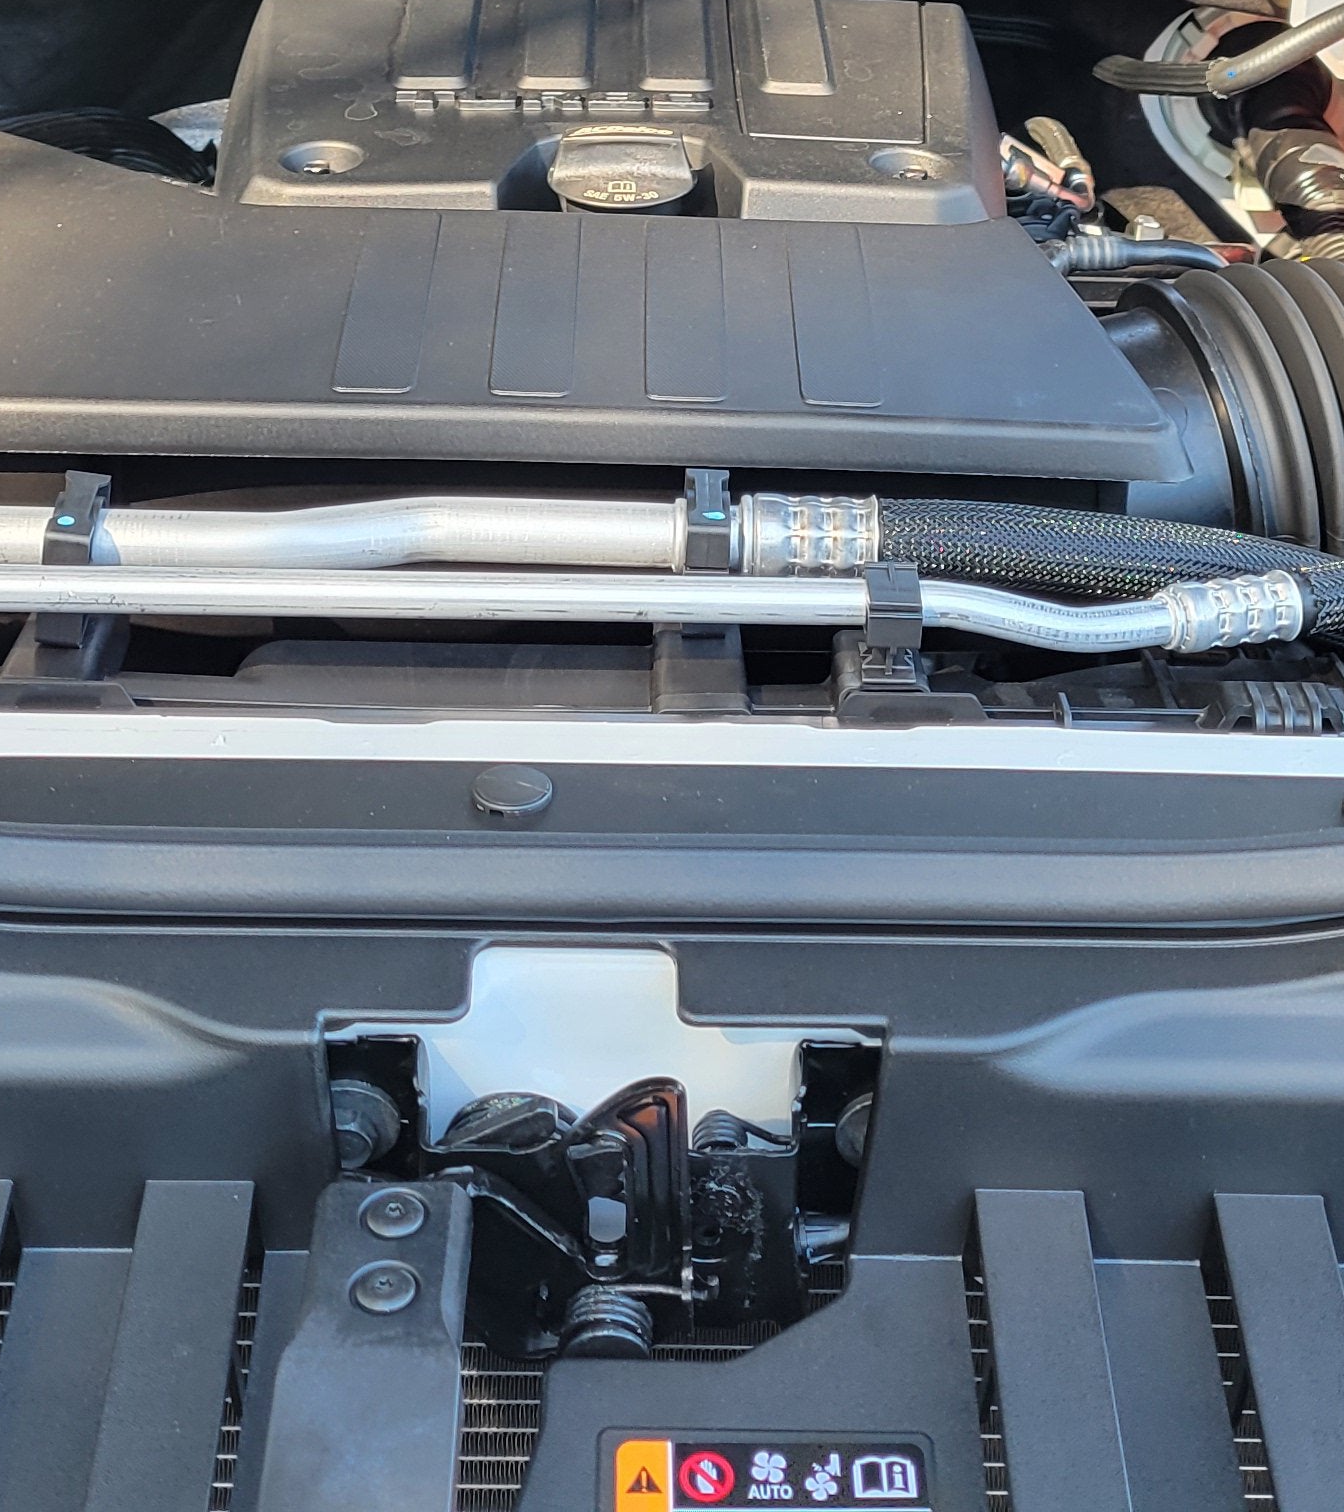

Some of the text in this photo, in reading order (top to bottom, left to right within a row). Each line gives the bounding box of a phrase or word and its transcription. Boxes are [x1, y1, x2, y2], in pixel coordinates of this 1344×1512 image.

[583, 189, 659, 202] SAE 5W-30
[747, 1482, 794, 1501] AUTO
